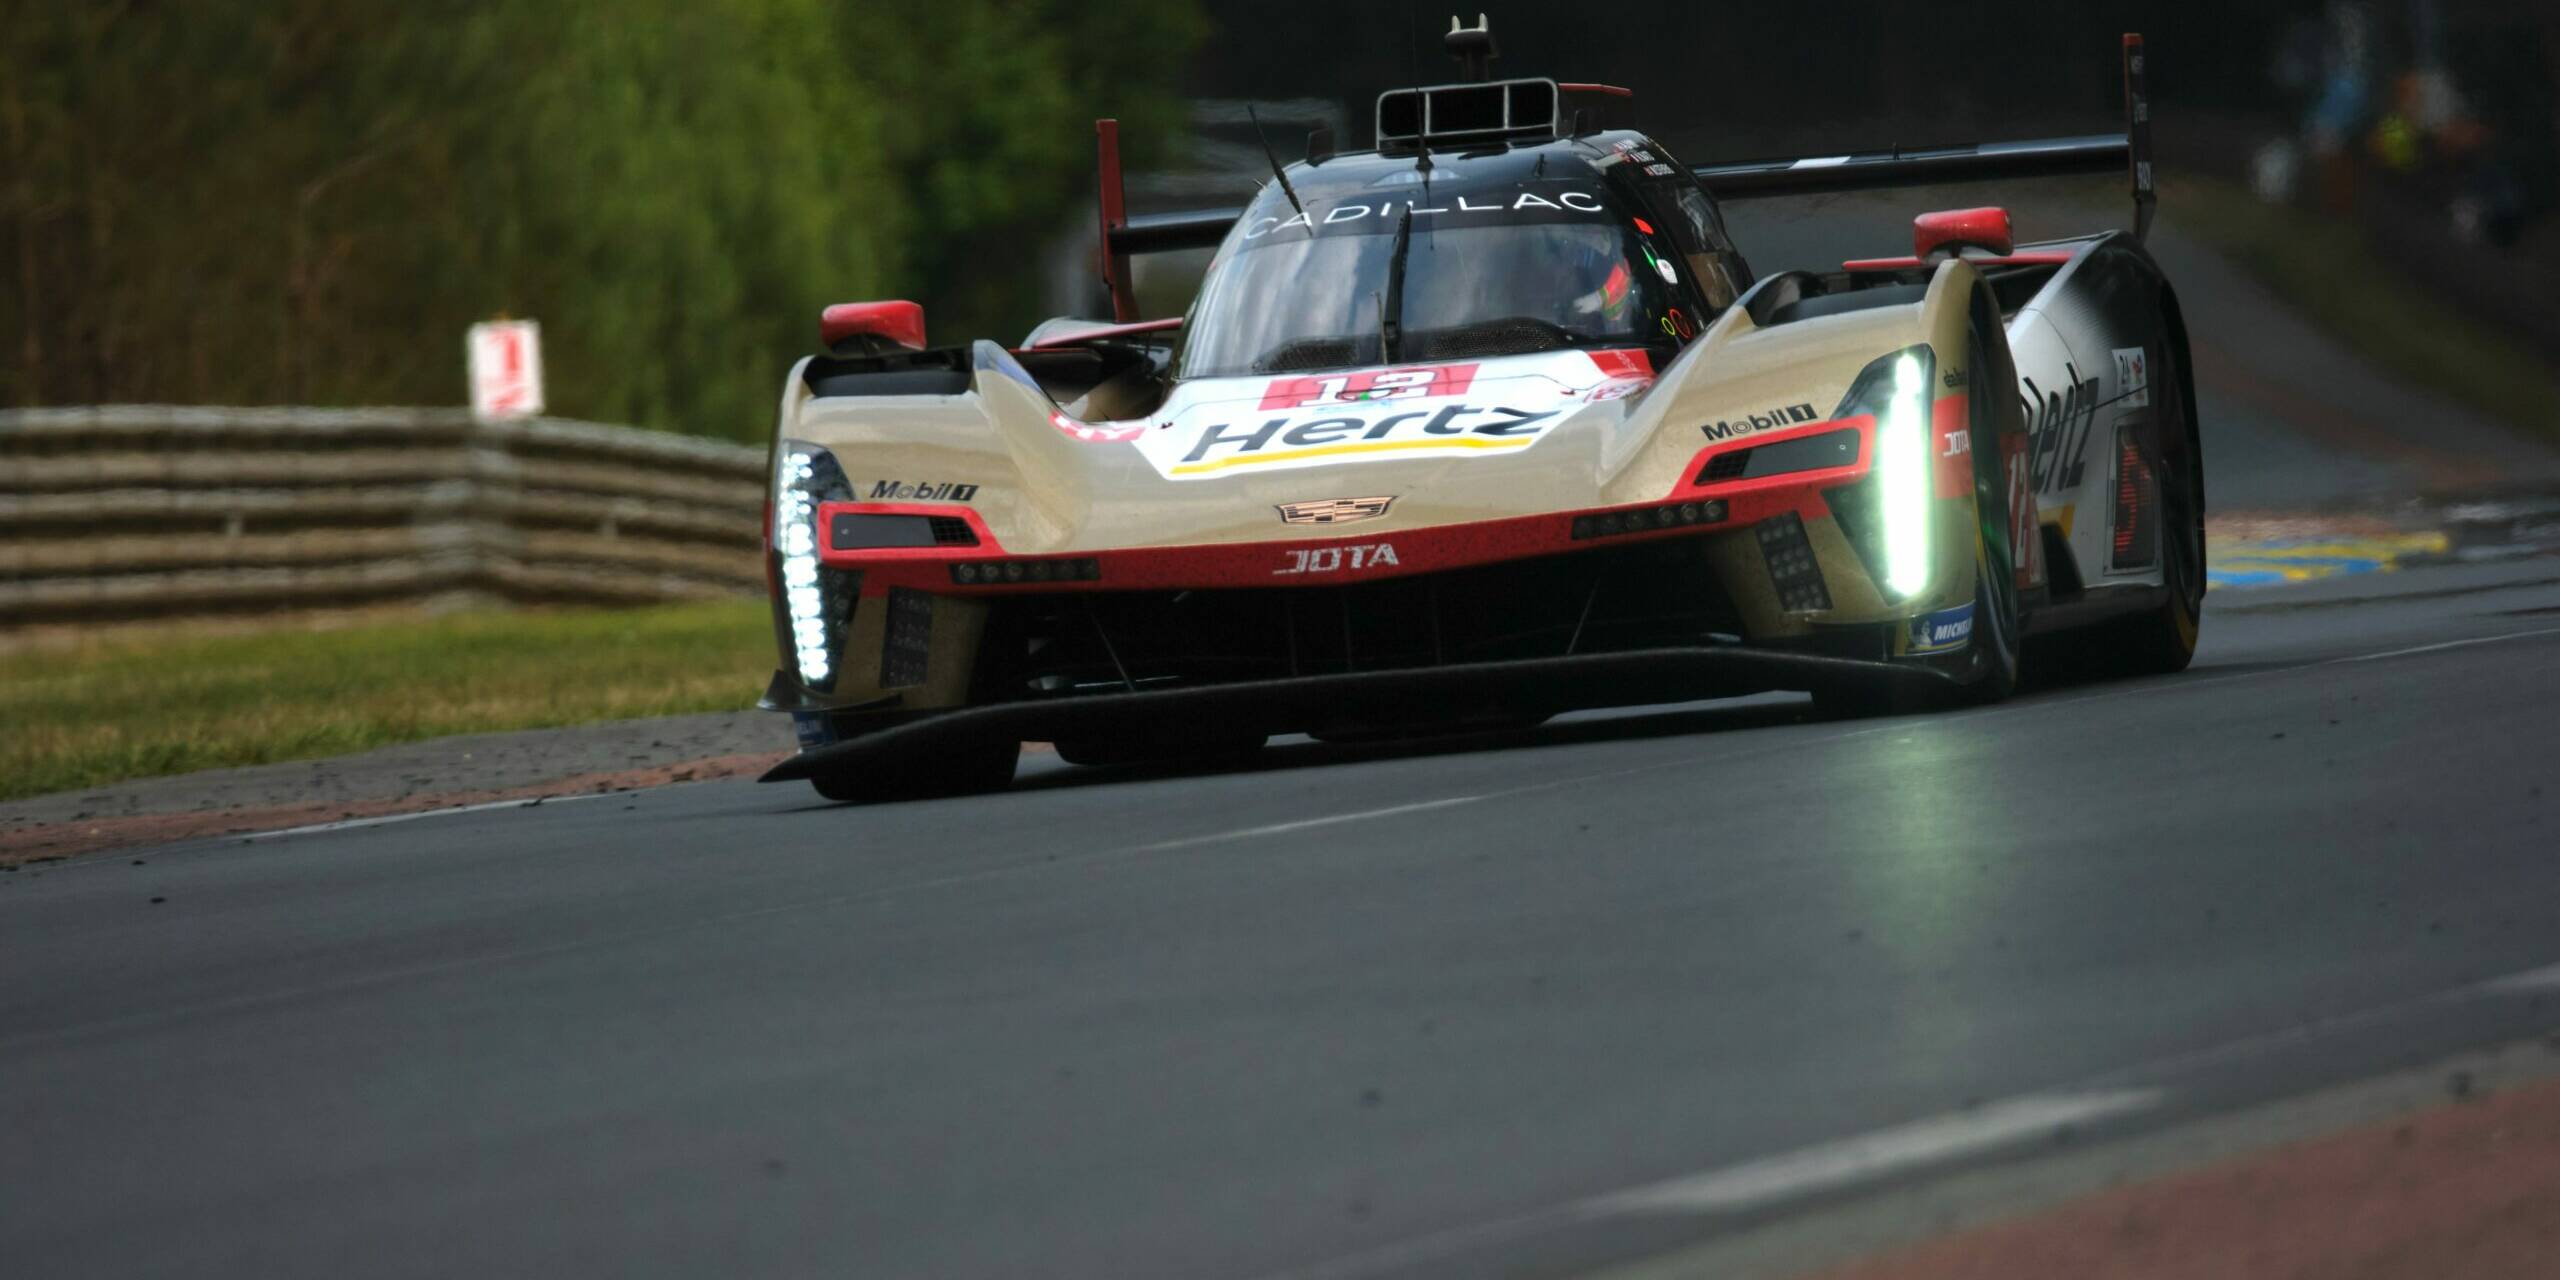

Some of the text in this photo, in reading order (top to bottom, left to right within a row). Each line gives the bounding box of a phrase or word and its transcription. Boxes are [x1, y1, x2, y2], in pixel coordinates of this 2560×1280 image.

[1244, 193, 1603, 240] CADILLAC
[1180, 404, 1563, 463] Hertz
[1700, 408, 1789, 441] Mobil
[869, 479, 954, 500] Mobil
[1272, 543, 1400, 575] JOTA
